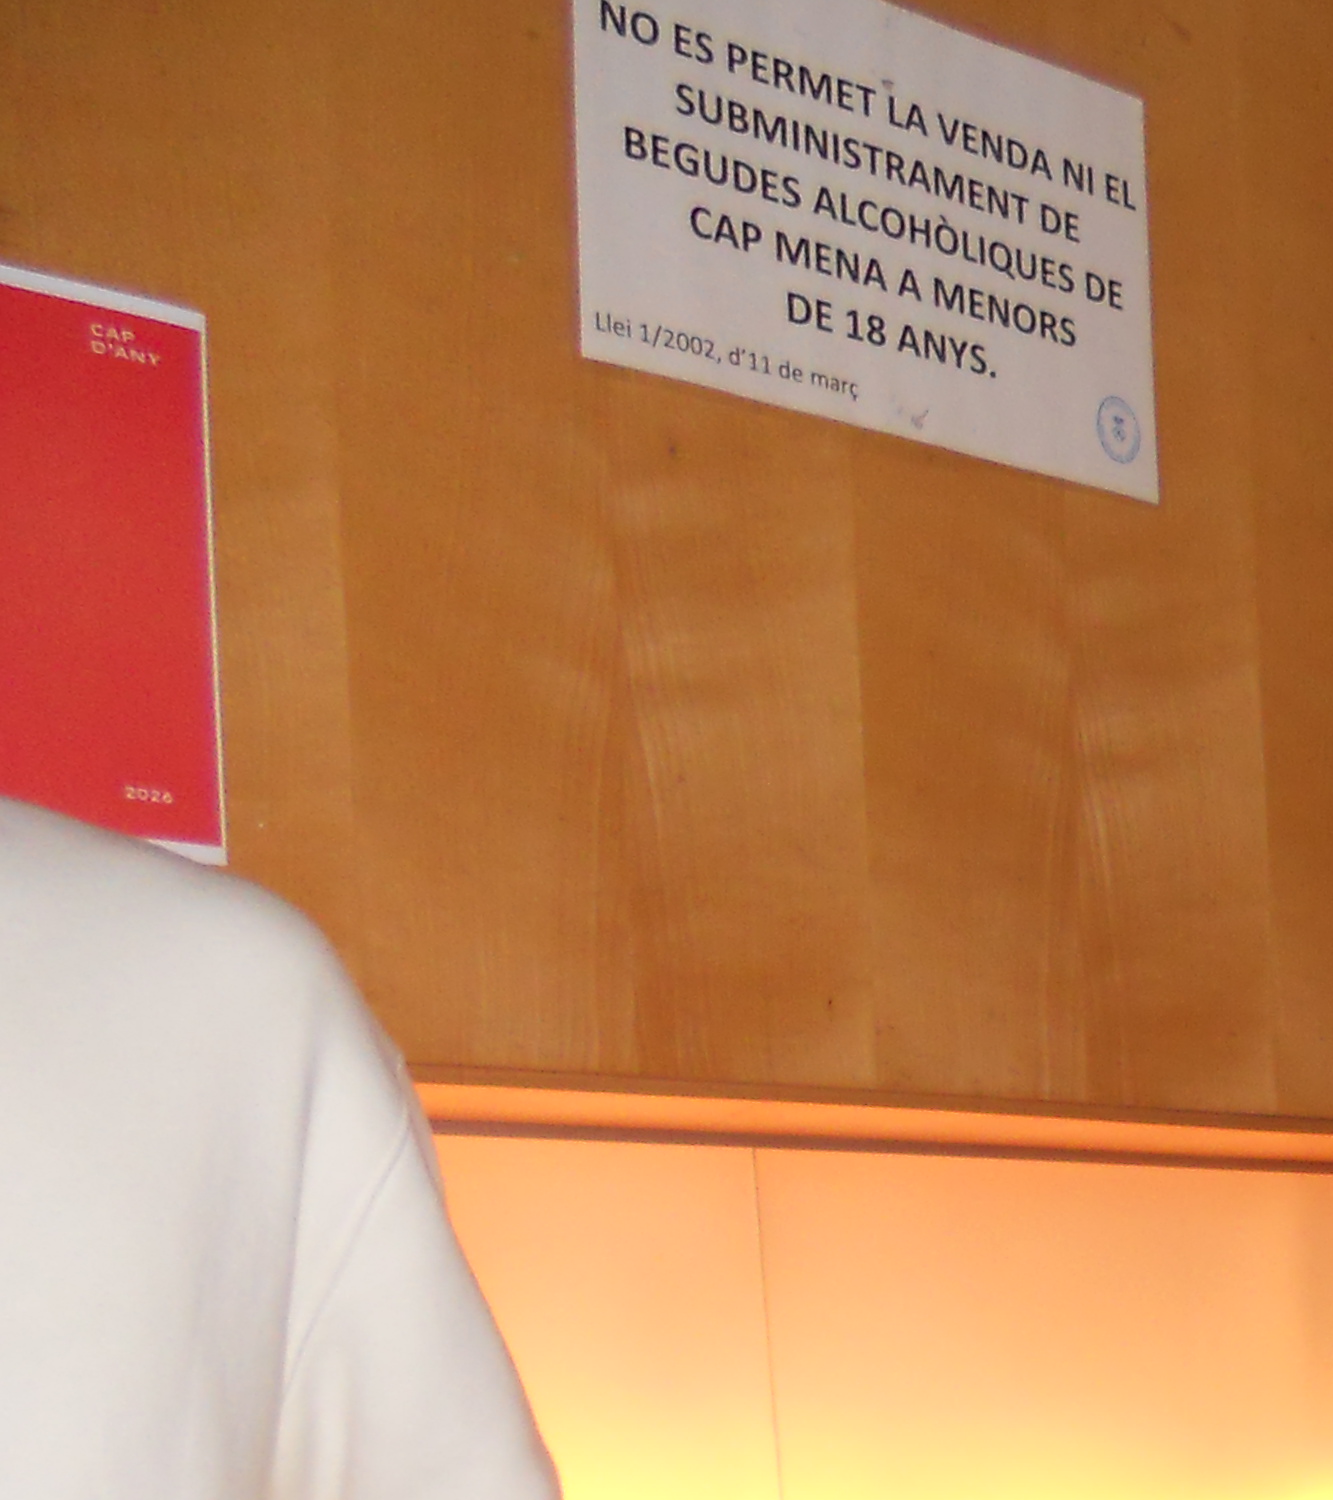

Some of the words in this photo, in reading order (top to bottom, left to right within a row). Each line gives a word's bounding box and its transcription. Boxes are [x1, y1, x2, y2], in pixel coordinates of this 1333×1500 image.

[599, 1, 660, 47] NO
[672, 21, 715, 65] ES
[726, 40, 878, 118] PERMET
[886, 93, 929, 138] LA
[936, 111, 1054, 182] VENDA
[1062, 156, 1095, 197] NI
[1104, 172, 1137, 212] EL
[675, 82, 1031, 225] SUBMINISTRAMENT
[1039, 202, 1082, 244] DE
[623, 125, 803, 209] BEGUDES
[811, 185, 1077, 294] ALCOHÒLIQUES
[1084, 270, 1124, 312] DE
[689, 204, 763, 254] CAP
[774, 229, 889, 293] MENA
[896, 267, 923, 303] A
[932, 276, 1077, 348] MENORS
[90, 324, 136, 343] CAP
[91, 340, 161, 367] D'ANY
[595, 311, 632, 339] Llei
[639, 323, 722, 366] 1/2002,
[778, 360, 804, 384] de
[810, 371, 859, 402] març
[786, 290, 834, 334] DE
[845, 308, 887, 348] 18
[896, 323, 997, 379] ANYS.
